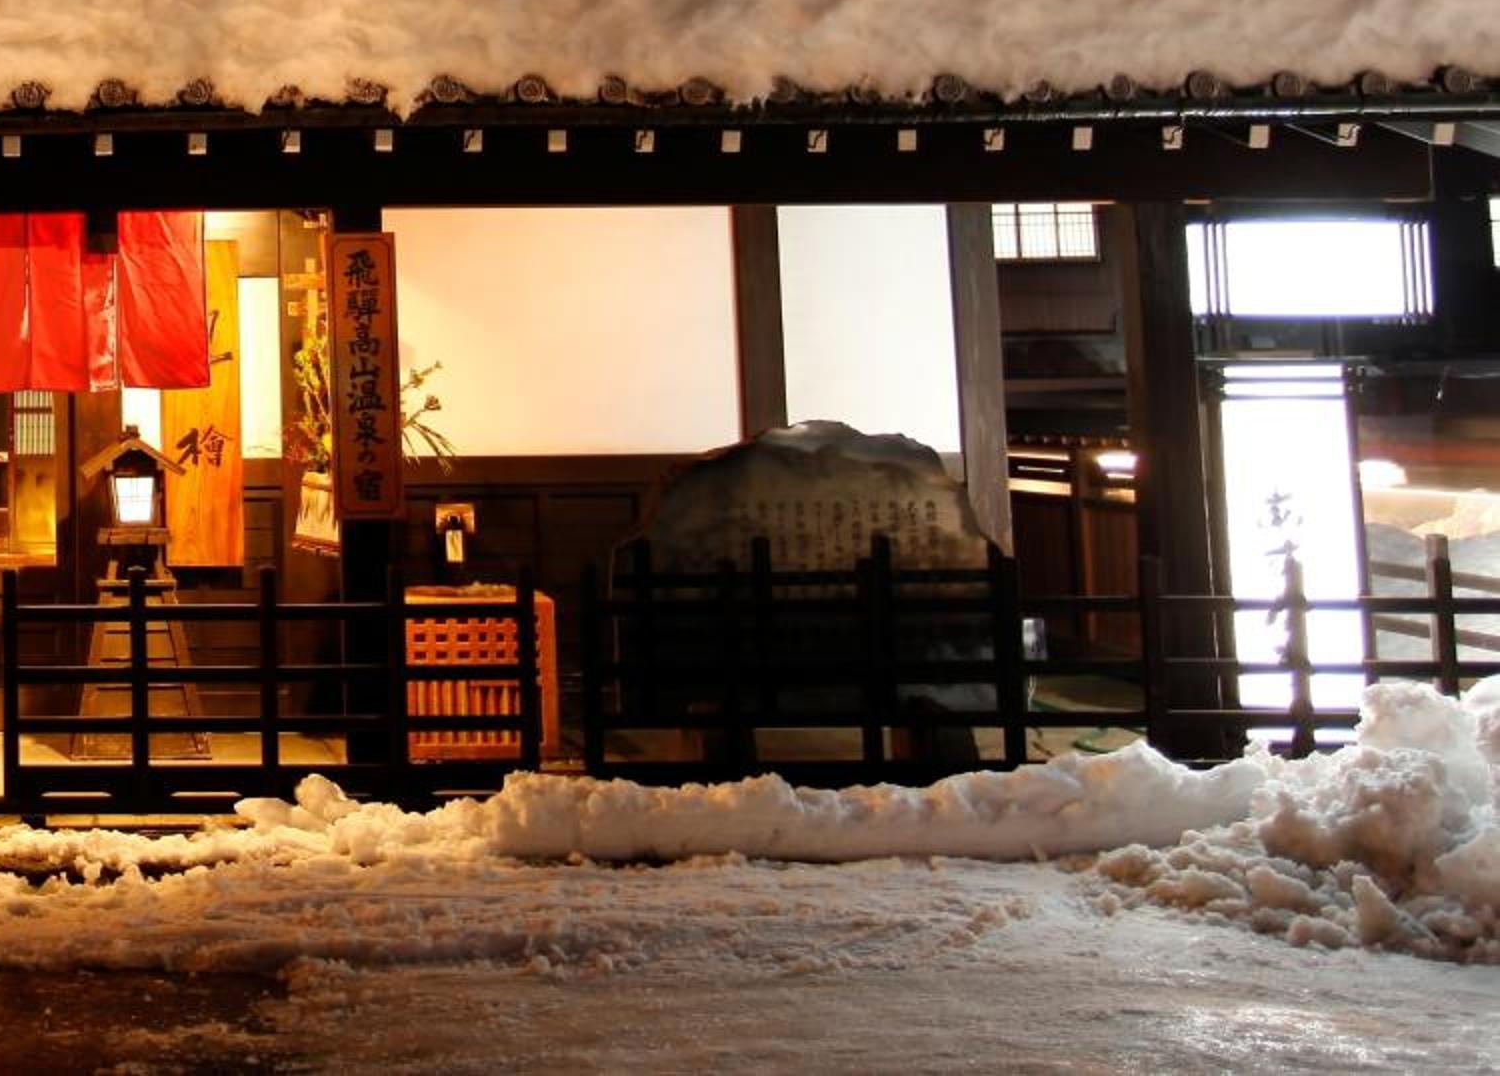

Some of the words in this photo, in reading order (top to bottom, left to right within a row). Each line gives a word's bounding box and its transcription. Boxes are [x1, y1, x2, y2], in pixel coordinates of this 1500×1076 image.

[344, 247, 386, 501] 飛騨高山温泉の宿
